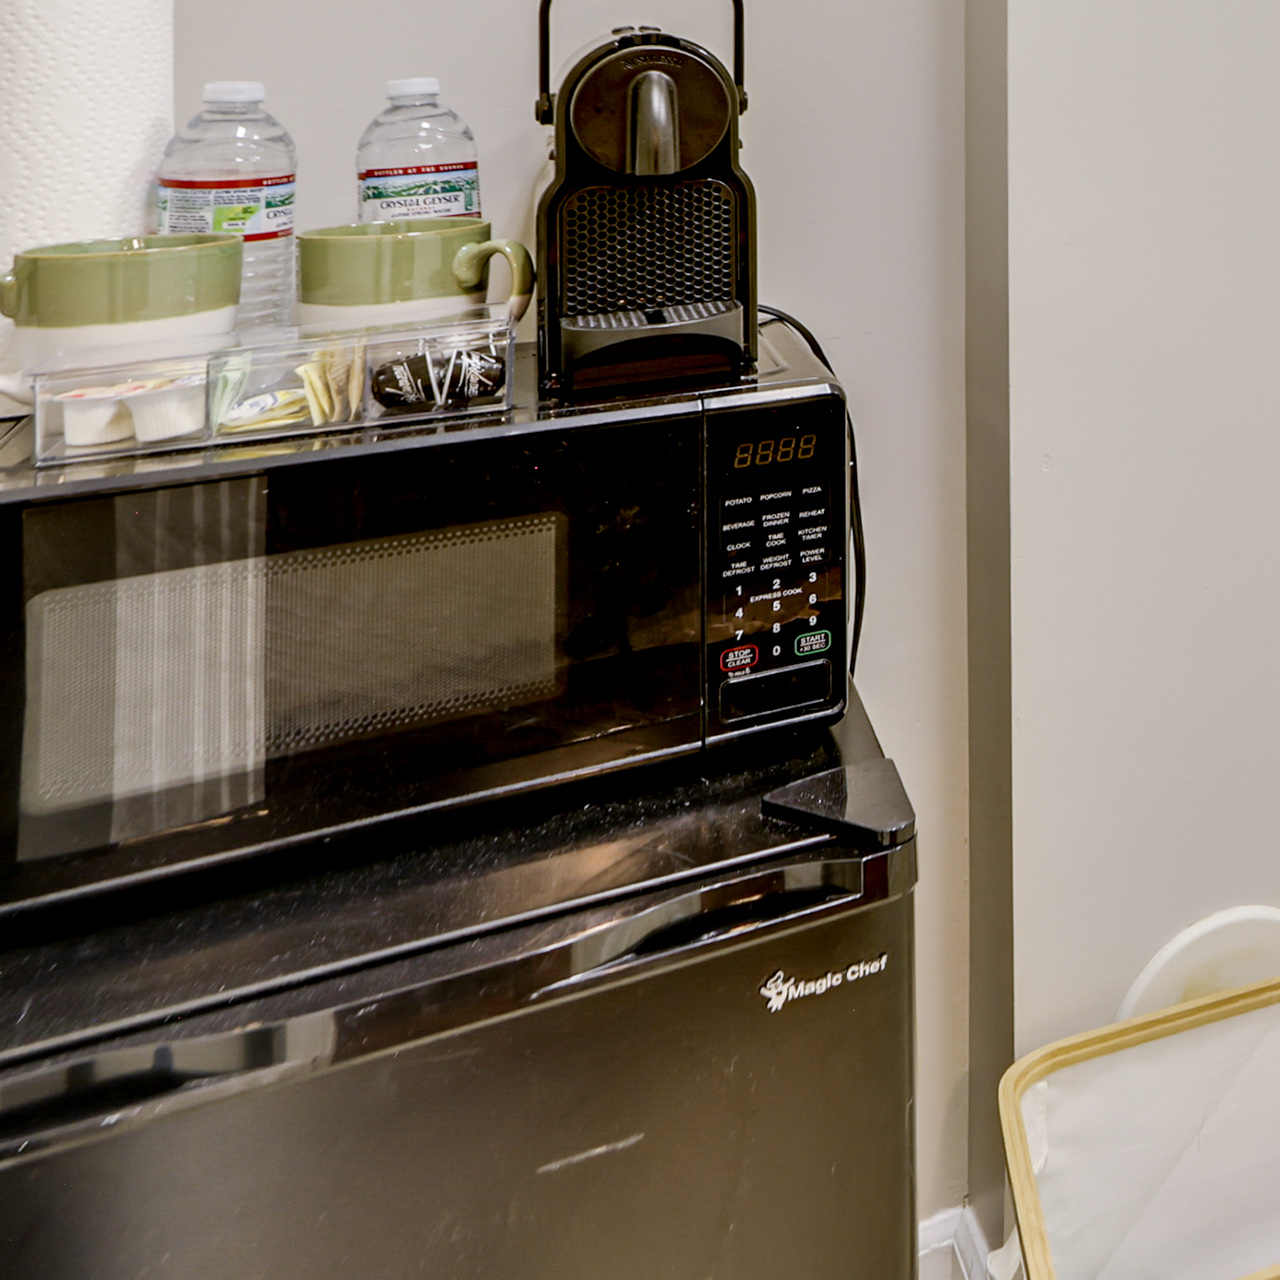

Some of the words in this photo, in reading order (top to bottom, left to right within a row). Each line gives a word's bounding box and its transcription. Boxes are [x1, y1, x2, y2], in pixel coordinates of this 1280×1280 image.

[380, 198, 420, 210] CRYSTAL
[423, 194, 461, 206] GEYSER
[802, 486, 822, 494] PIZZA
[760, 491, 792, 501] POPCORN
[725, 497, 752, 507] POTATO
[762, 511, 790, 521] FROZEN
[799, 508, 825, 518] REHEAT
[722, 520, 755, 531] BEVERAGE
[763, 518, 789, 527] DINNER
[798, 526, 827, 536] KITCHEN
[802, 533, 822, 541] TIMER
[727, 541, 751, 551] CLOCK
[766, 539, 786, 547] COOK
[800, 548, 825, 557] POWER
[763, 554, 789, 564] WEIGHT
[802, 555, 822, 563] LEVEL
[731, 561, 747, 569] TIME
[760, 560, 792, 570] DEFROST
[722, 566, 755, 577] DEFROST
[809, 572, 817, 582] 3
[773, 579, 780, 589] 2
[736, 586, 742, 596] 1
[750, 590, 781, 603] EXPRESS
[782, 588, 803, 597] COOK
[809, 594, 817, 604] 6
[773, 601, 780, 611] 5
[735, 607, 743, 618] 4
[809, 615, 817, 626] 9
[773, 623, 781, 633] 8
[735, 630, 743, 641] 7
[800, 633, 826, 645] START
[773, 645, 781, 656] 0
[812, 642, 826, 650] SEC
[728, 649, 751, 660] STOP
[727, 658, 751, 668] CLEAR
[788, 972, 843, 1001] Magic
[846, 954, 888, 982] Chef
